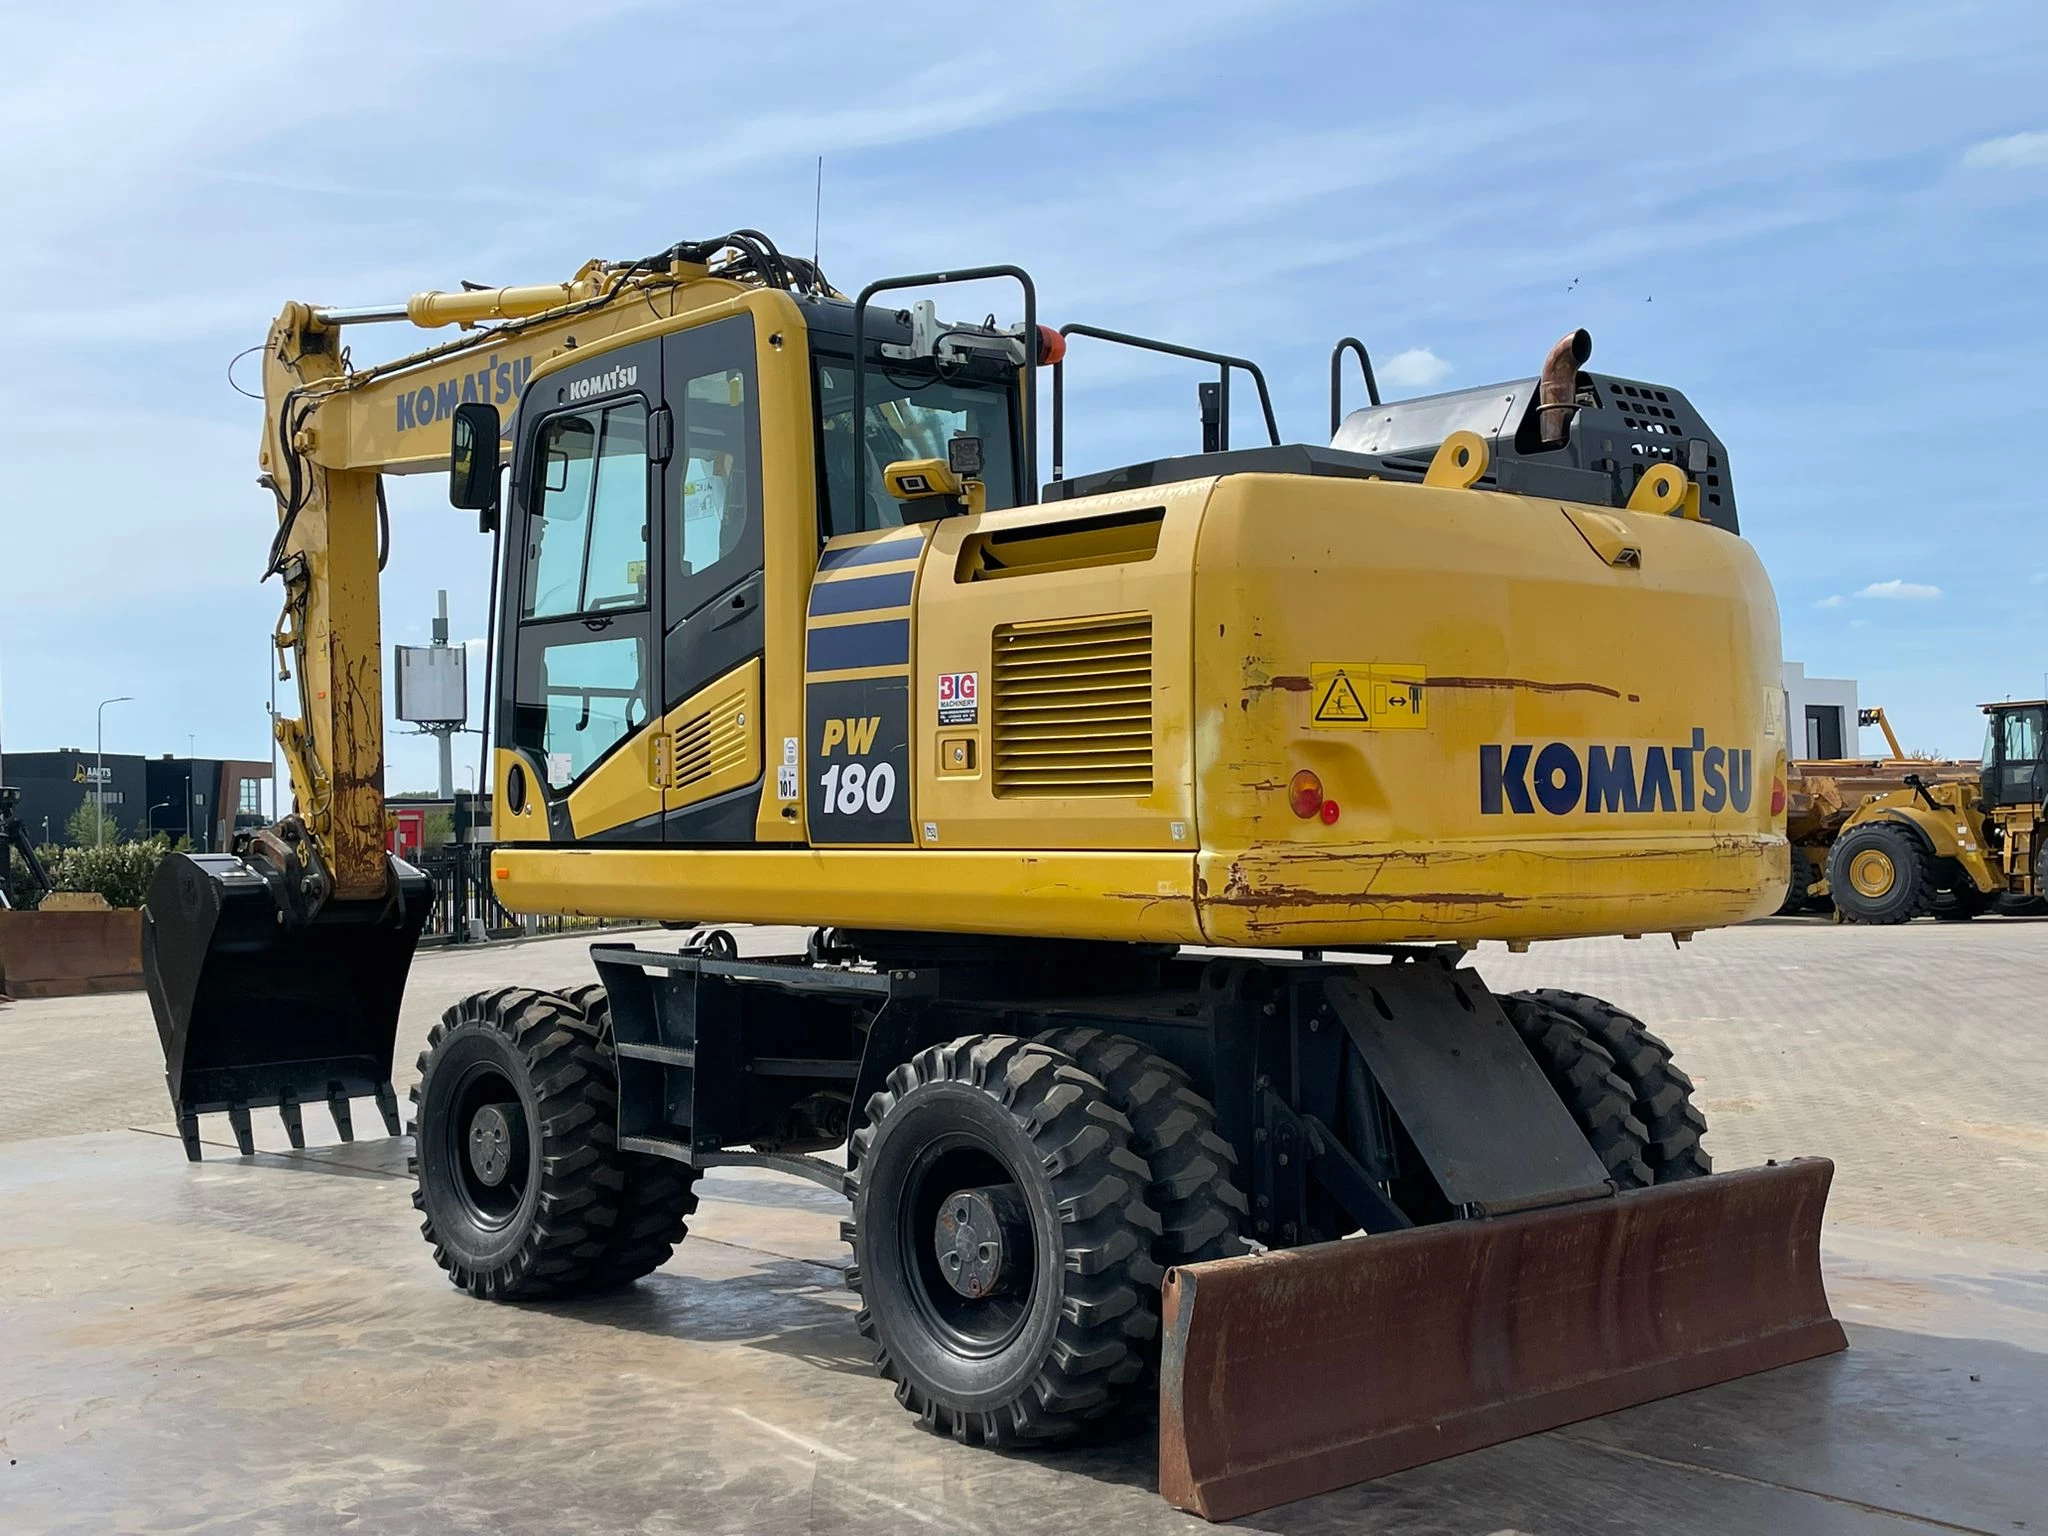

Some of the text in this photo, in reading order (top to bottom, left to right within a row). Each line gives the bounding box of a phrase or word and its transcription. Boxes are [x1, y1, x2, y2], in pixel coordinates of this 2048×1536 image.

[396, 354, 532, 432] KOMATSU
[570, 365, 637, 400] KOMATSU
[821, 716, 881, 757] PW
[820, 762, 896, 815] 180
[1480, 727, 1752, 816] KOMATSU
